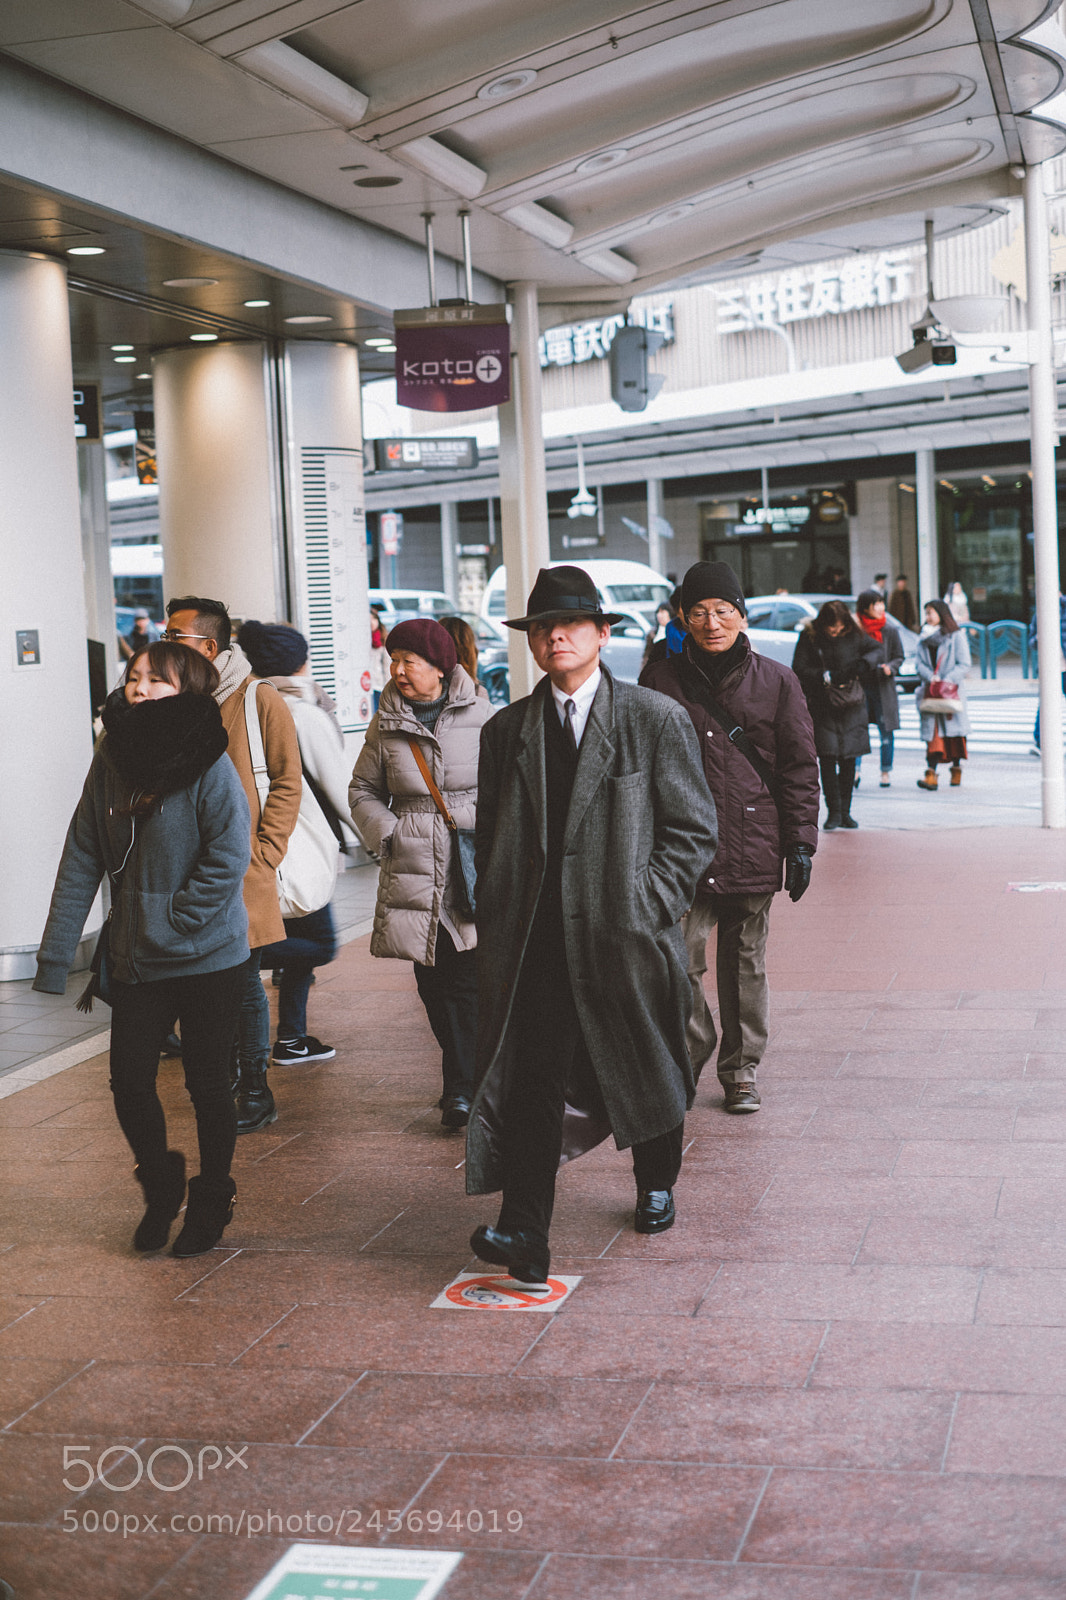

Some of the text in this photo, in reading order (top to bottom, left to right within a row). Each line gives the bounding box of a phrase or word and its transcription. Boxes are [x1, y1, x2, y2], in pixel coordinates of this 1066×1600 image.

[717, 248, 913, 334] 三井住友銀行
